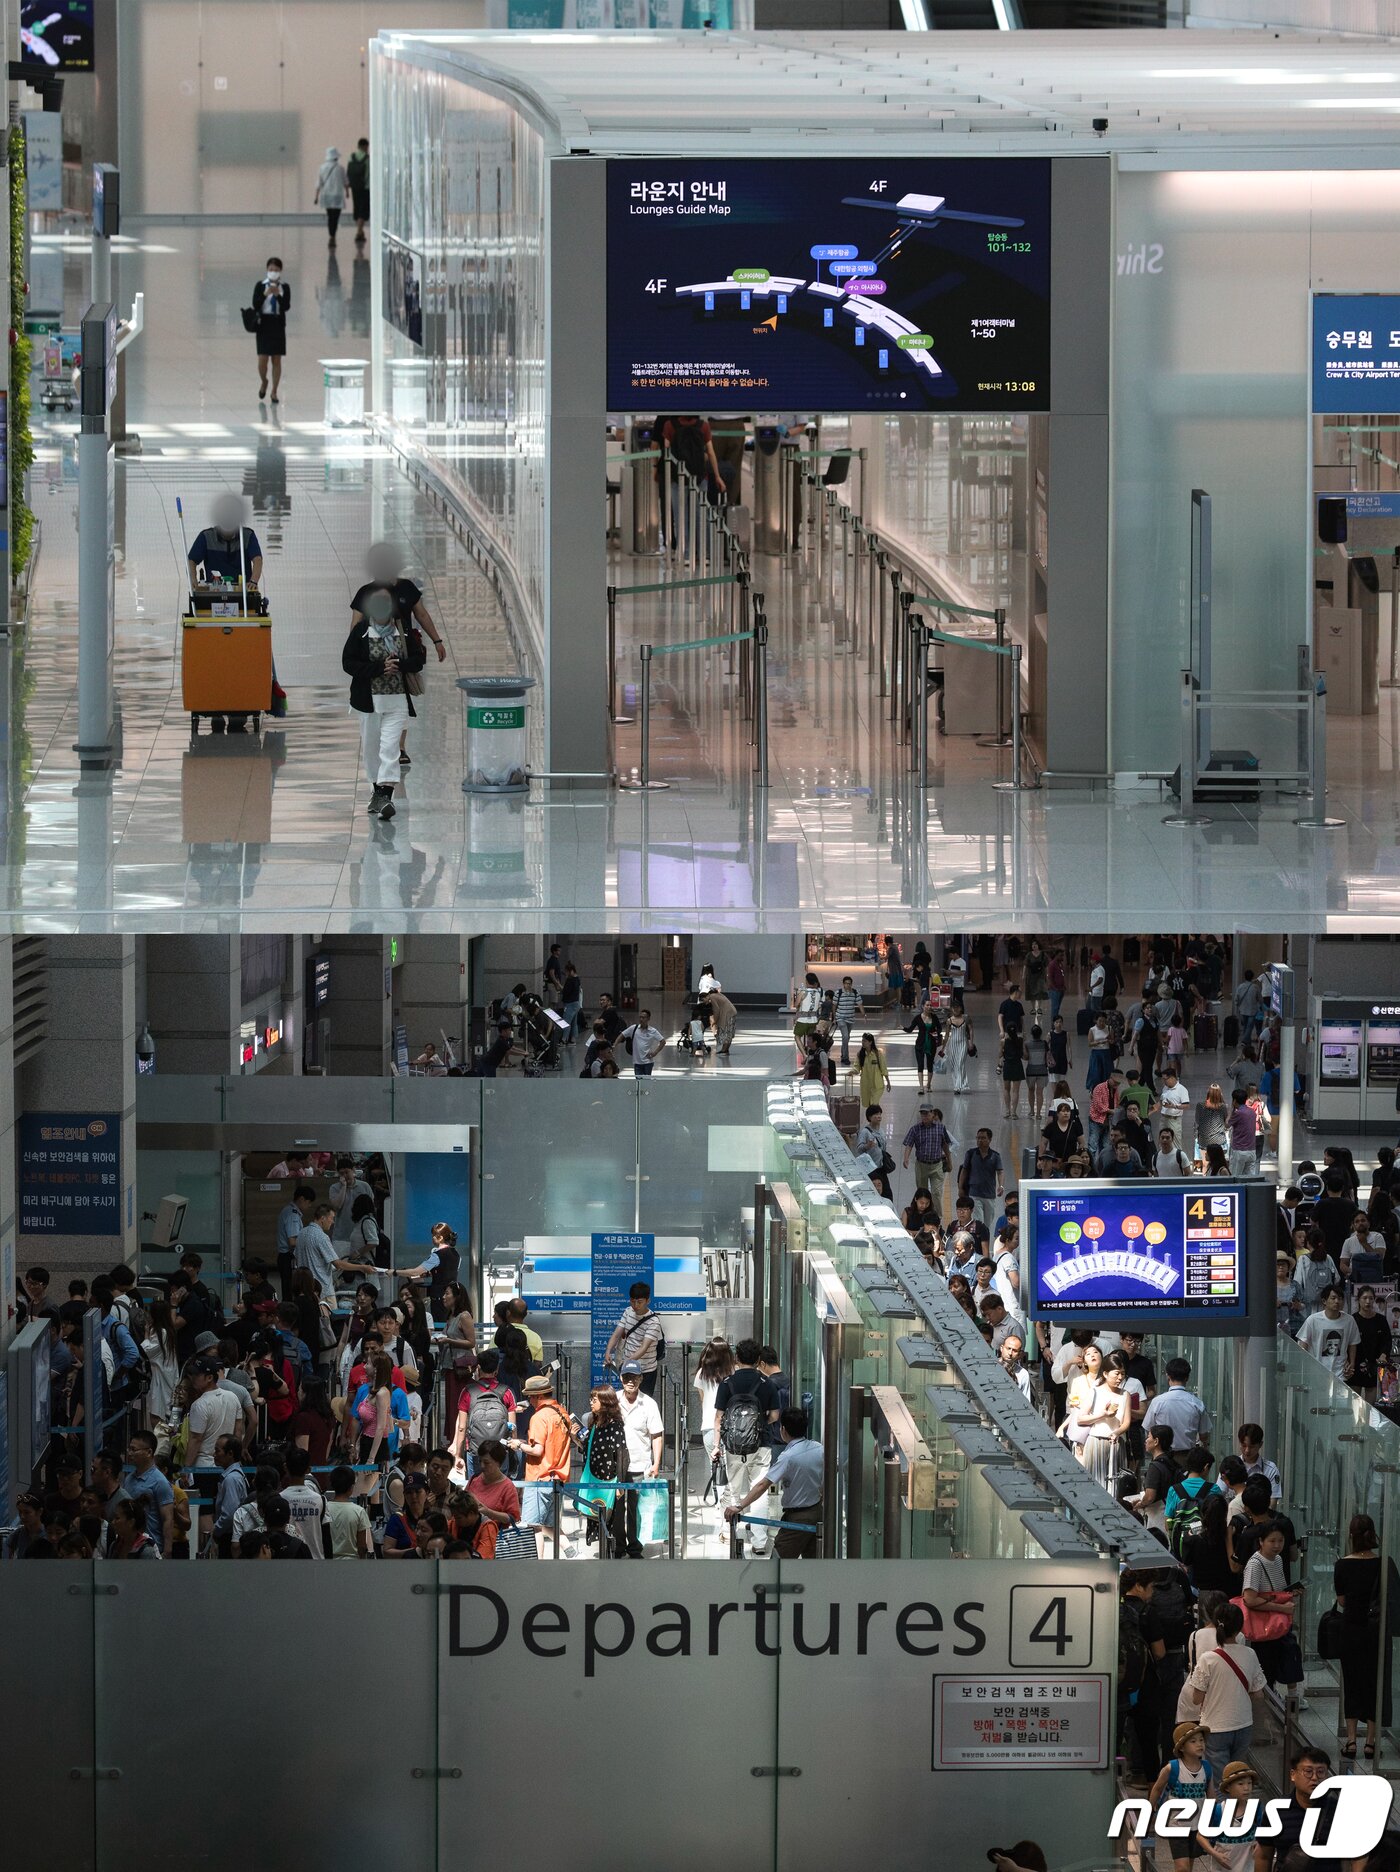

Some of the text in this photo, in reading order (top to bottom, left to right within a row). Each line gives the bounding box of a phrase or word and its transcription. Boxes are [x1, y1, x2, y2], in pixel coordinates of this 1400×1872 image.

[630, 181, 726, 202] 라운지 안내
[869, 180, 888, 192] 4F
[630, 204, 731, 217] Lounges Guide Map
[987, 242, 1031, 252] 101~132
[645, 279, 668, 293] 4F
[971, 319, 1015, 327] 제1여객터미널
[970, 329, 996, 338] 1~50
[1326, 330, 1372, 349] 승무원
[1351, 371, 1364, 379] City
[1366, 371, 1388, 379] Airport
[648, 379, 656, 387] 번
[657, 379, 692, 387] 이동하시면
[693, 379, 707, 387] 다시
[731, 379, 739, 387] 수
[740, 379, 770, 387] 없습니다.
[1005, 382, 1036, 391] 13:08
[23, 1151, 116, 1163] 신속한 보안검색을 위하여
[101, 1173, 116, 1184] 등은
[23, 1195, 116, 1207] 미리 바구니에 담아 주시기
[1042, 1200, 1056, 1211] 3F
[1188, 1199, 1206, 1219] 4
[23, 1216, 57, 1227] 바랍니다.
[658, 1301, 693, 1309] Declaration
[449, 1584, 1073, 1677] Departures 4
[993, 1707, 1050, 1718] 보안 검색중
[973, 1719, 1070, 1731] 방해 폭행 폭언은
[981, 1732, 1063, 1743] 처벌을 받습니다.
